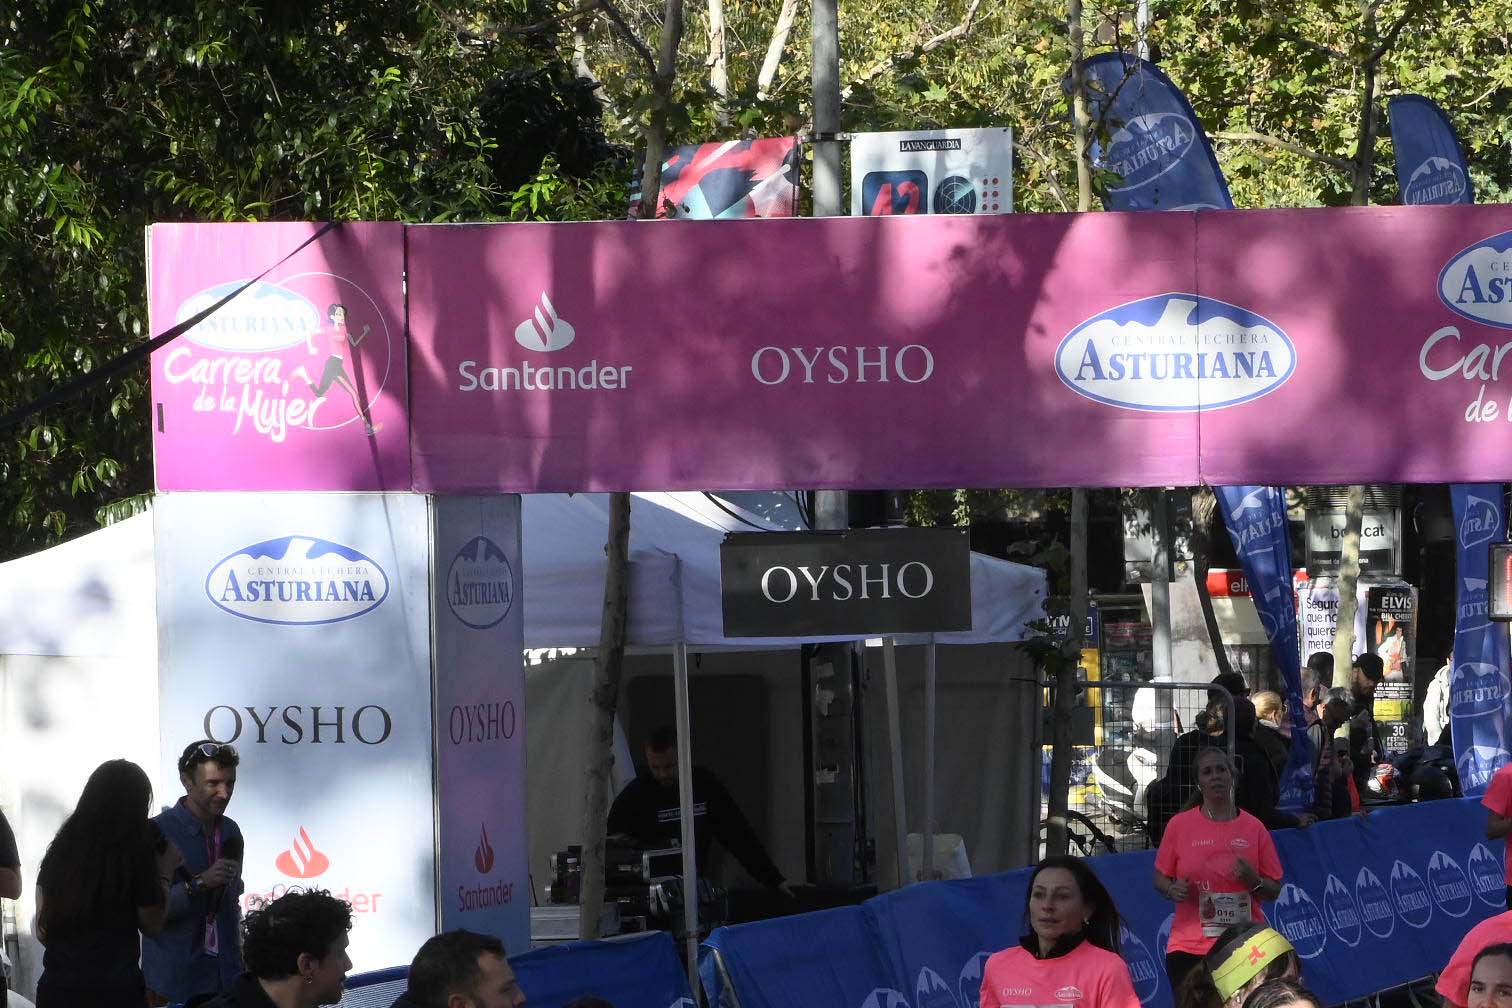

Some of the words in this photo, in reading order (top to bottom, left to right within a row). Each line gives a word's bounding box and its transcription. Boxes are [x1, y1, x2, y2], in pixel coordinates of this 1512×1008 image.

[164, 347, 282, 384] Carrera
[459, 359, 632, 392] Santander
[751, 344, 934, 385] OYSHO
[1074, 338, 1277, 381] ASTURIANA
[193, 385, 215, 411] de
[219, 384, 236, 411] la
[233, 381, 326, 443] Mujer
[1465, 384, 1500, 422] de
[220, 569, 376, 602] ASTURIANA
[452, 569, 510, 606] ASTURIANA
[761, 561, 935, 603] OYSHO
[1381, 596, 1413, 609] ELVIS
[204, 705, 392, 745] OYSHO
[450, 700, 515, 746] OYSHO
[458, 880, 514, 912] Santander
[1002, 987, 1031, 996] OYSHO
